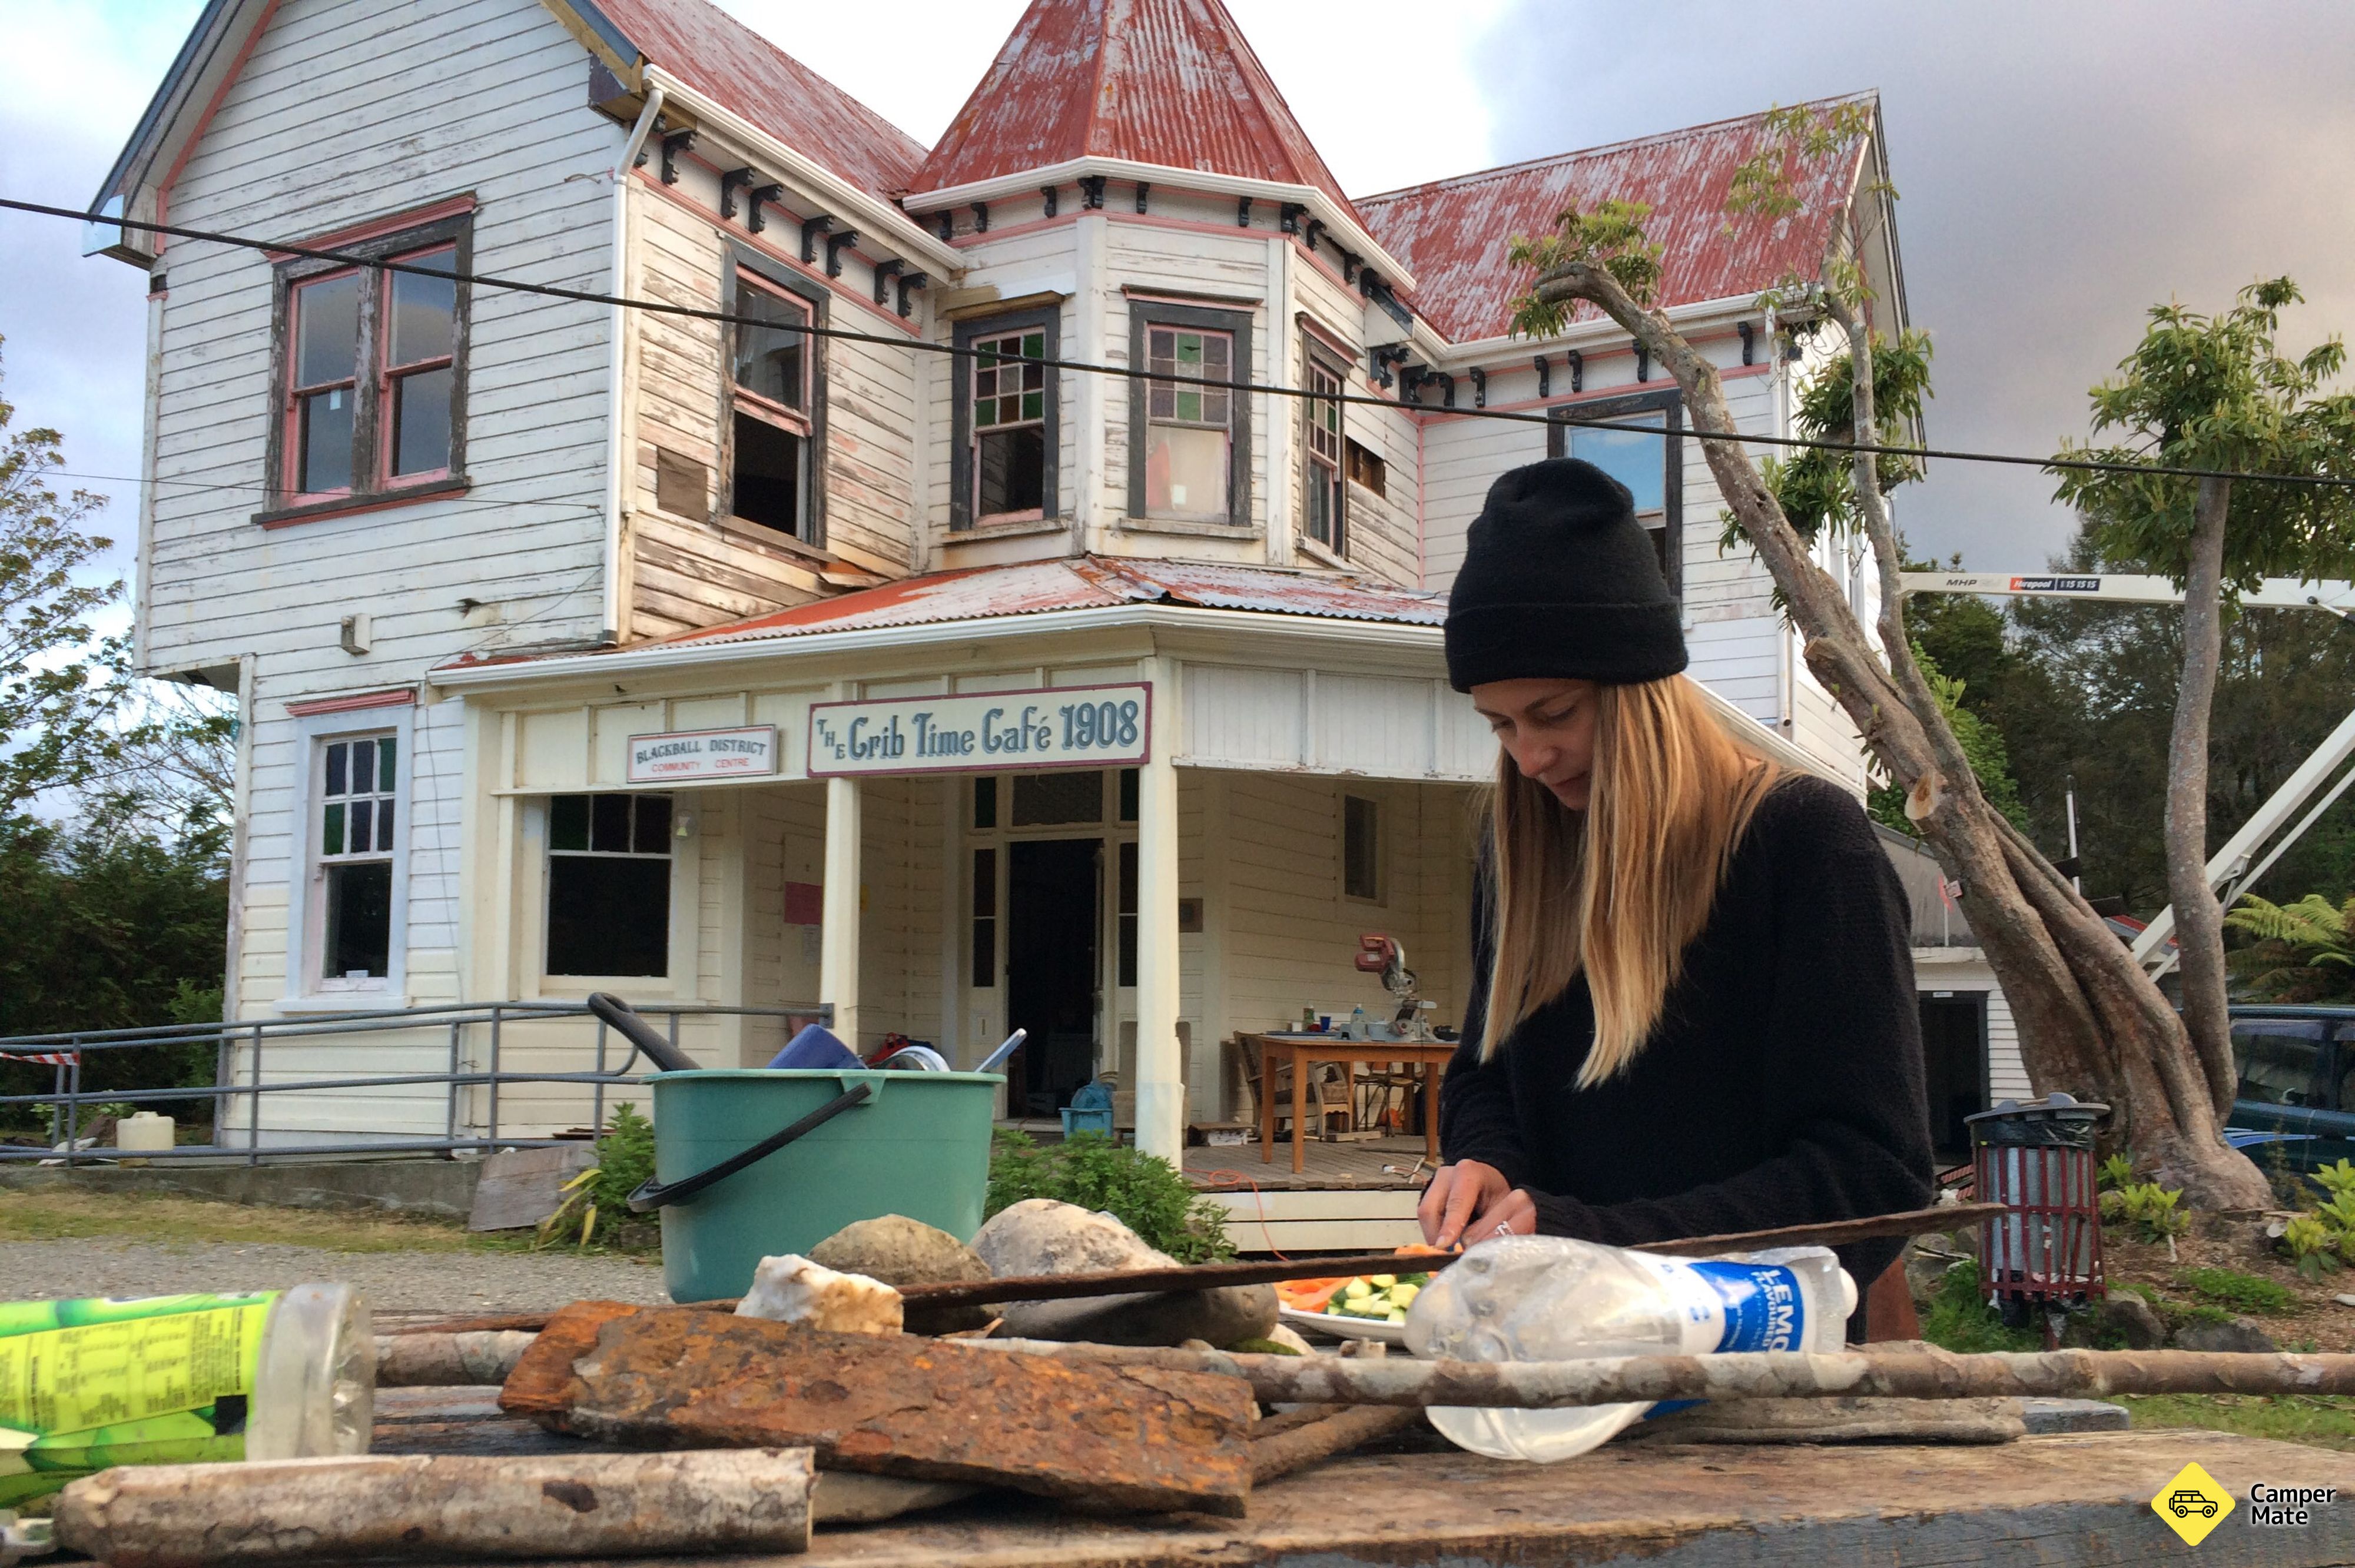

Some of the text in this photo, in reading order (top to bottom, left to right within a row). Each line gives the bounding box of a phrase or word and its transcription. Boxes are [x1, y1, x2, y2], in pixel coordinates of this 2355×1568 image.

[911, 712, 976, 758] Time
[982, 706, 1052, 754] Café
[1059, 700, 1138, 750] 1908
[636, 739, 767, 765] BLACKBALL DISTRICT
[652, 757, 749, 773] COMMUNITY CENTRE
